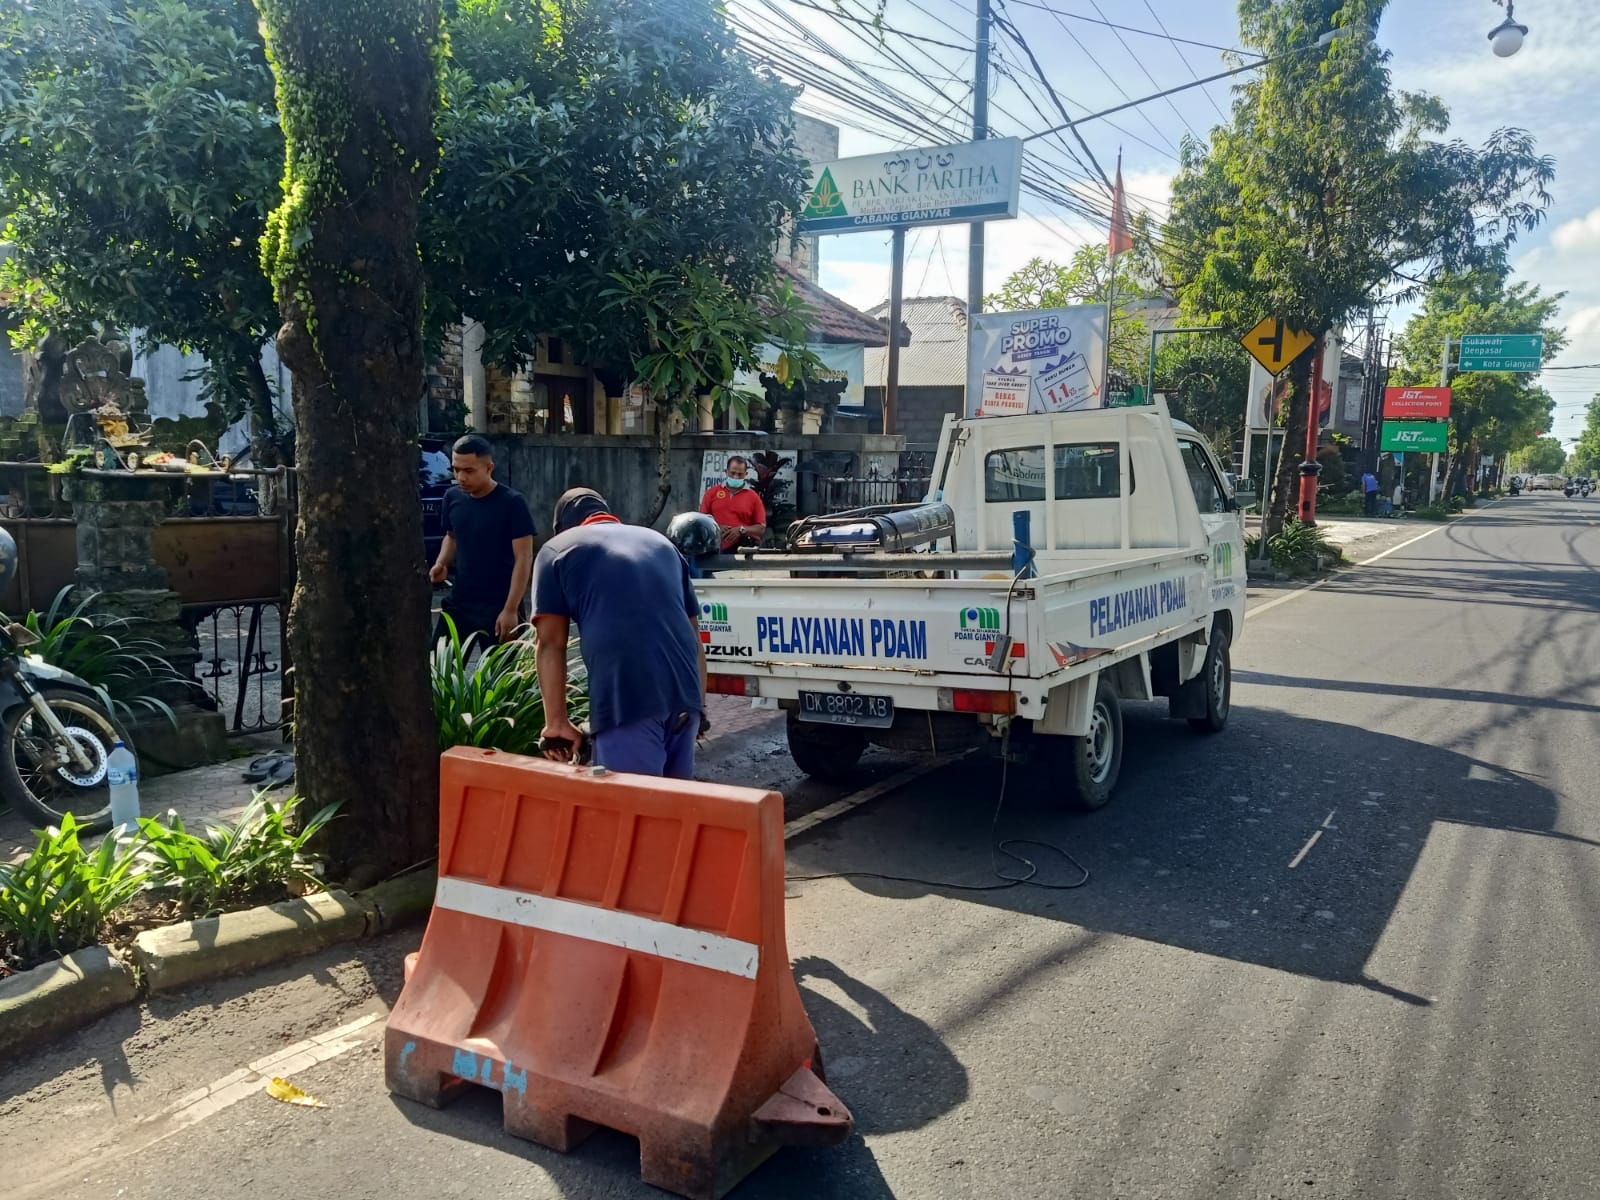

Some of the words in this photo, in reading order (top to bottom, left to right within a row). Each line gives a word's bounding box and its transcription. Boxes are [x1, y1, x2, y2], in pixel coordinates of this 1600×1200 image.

[853, 175, 909, 199] BANK
[917, 164, 999, 193] PARTHA
[854, 213, 898, 225] CABANG
[902, 208, 950, 221] GIANYAR
[1011, 315, 1059, 336] SUPER
[1001, 326, 1072, 354] PROMO
[1465, 337, 1503, 345] Sukawati
[1464, 347, 1503, 356] Denpasar
[1483, 360, 1501, 368] Kota
[1504, 360, 1536, 370] Gianyar
[1398, 391, 1424, 399] J&T
[1391, 431, 1424, 442] J&T
[1090, 583, 1159, 638] PELAYANAN
[1159, 575, 1187, 616] PDAM
[709, 625, 732, 633] GIANYAR
[756, 615, 866, 657] PELAYANAN
[870, 618, 928, 660] PDAM
[954, 631, 974, 641] PDAM
[705, 645, 753, 657] UZUKI
[804, 693, 823, 712] DK
[826, 695, 864, 716] 8802
[868, 696, 888, 718] KB
